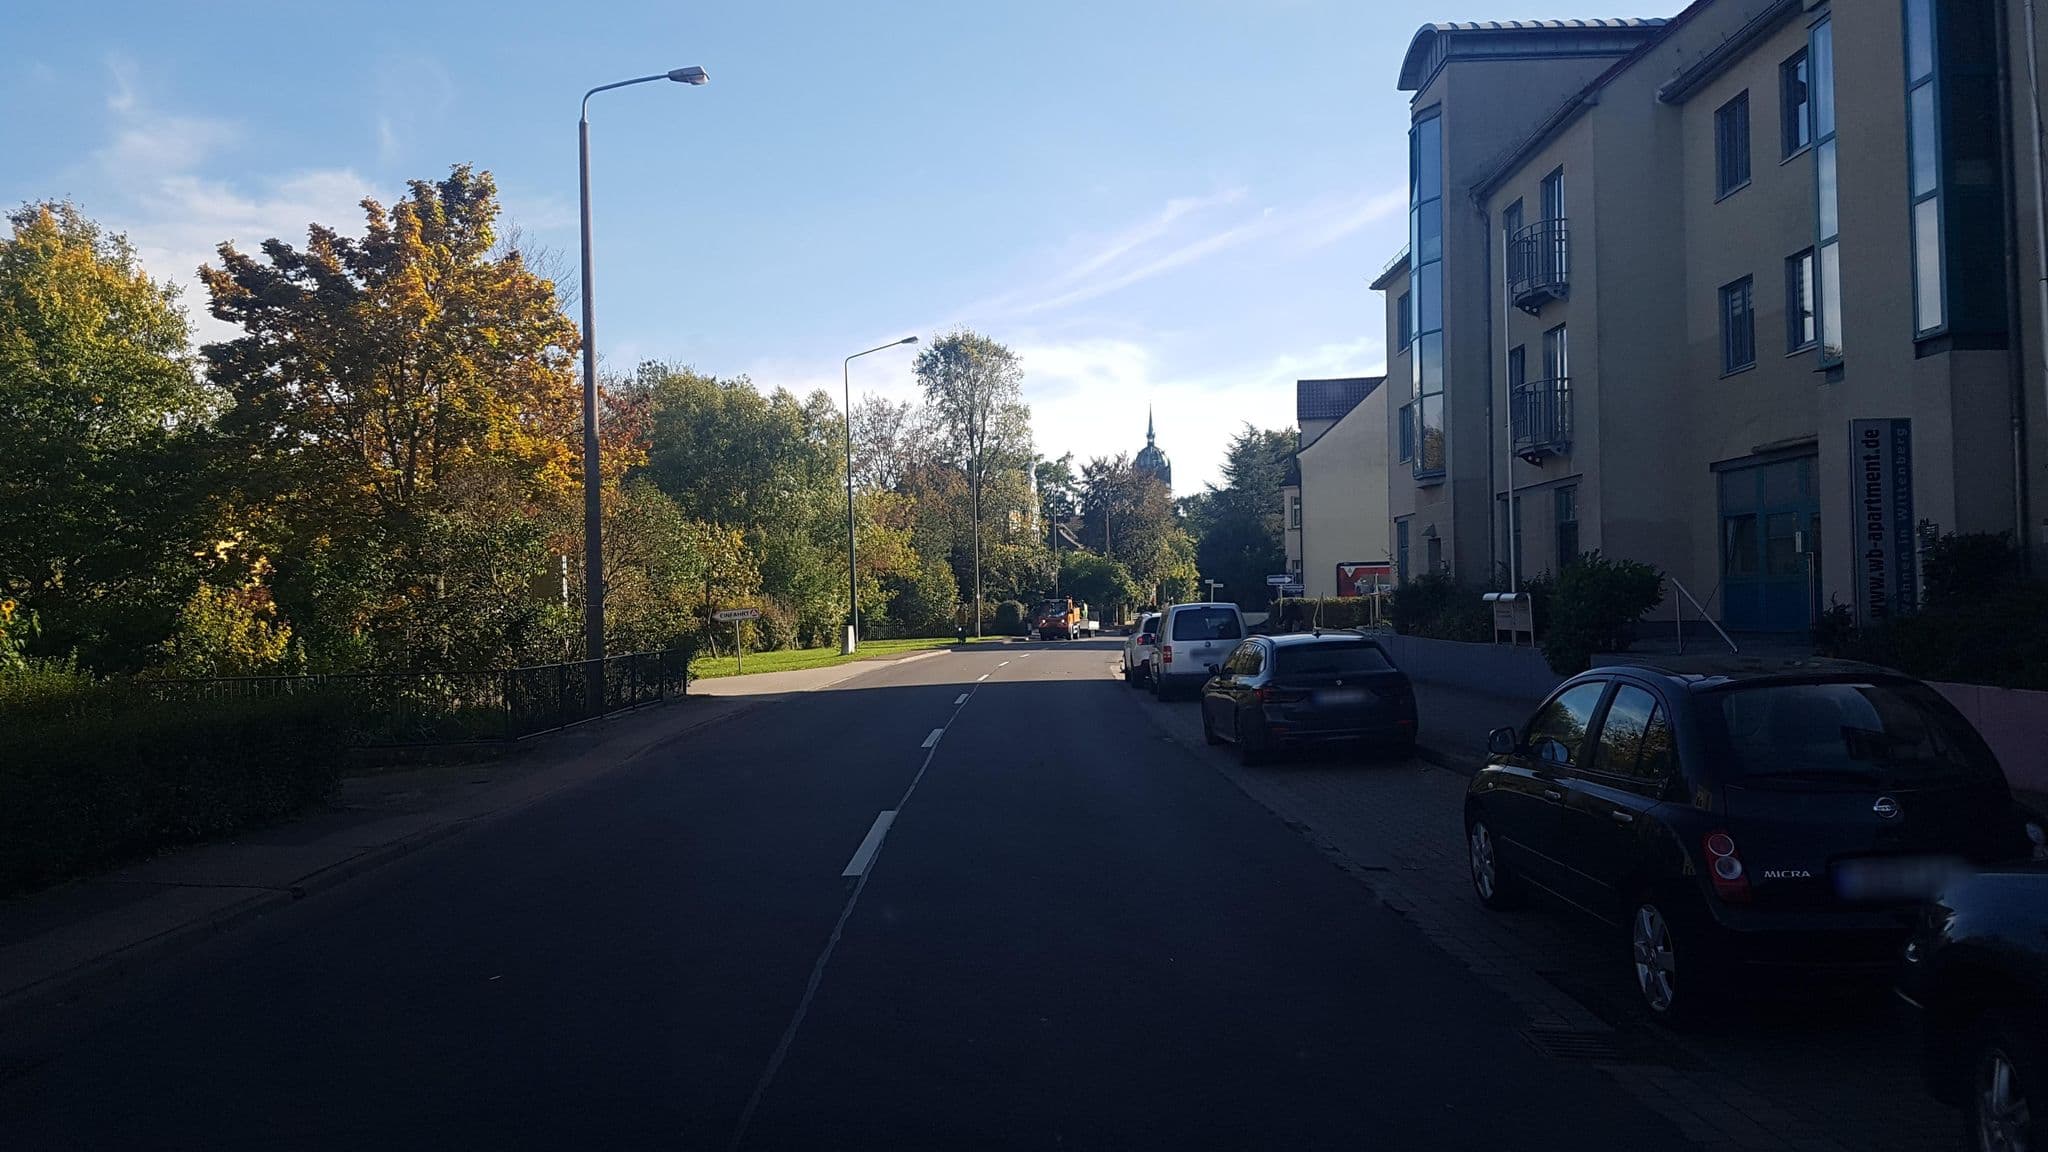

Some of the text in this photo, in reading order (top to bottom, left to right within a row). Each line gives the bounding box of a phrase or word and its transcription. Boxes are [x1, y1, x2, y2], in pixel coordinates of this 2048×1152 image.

[1895, 428, 1908, 521] Wittenberg
[1862, 428, 1885, 618] www.wb-apartment.de
[1763, 870, 1811, 878] MICRA
